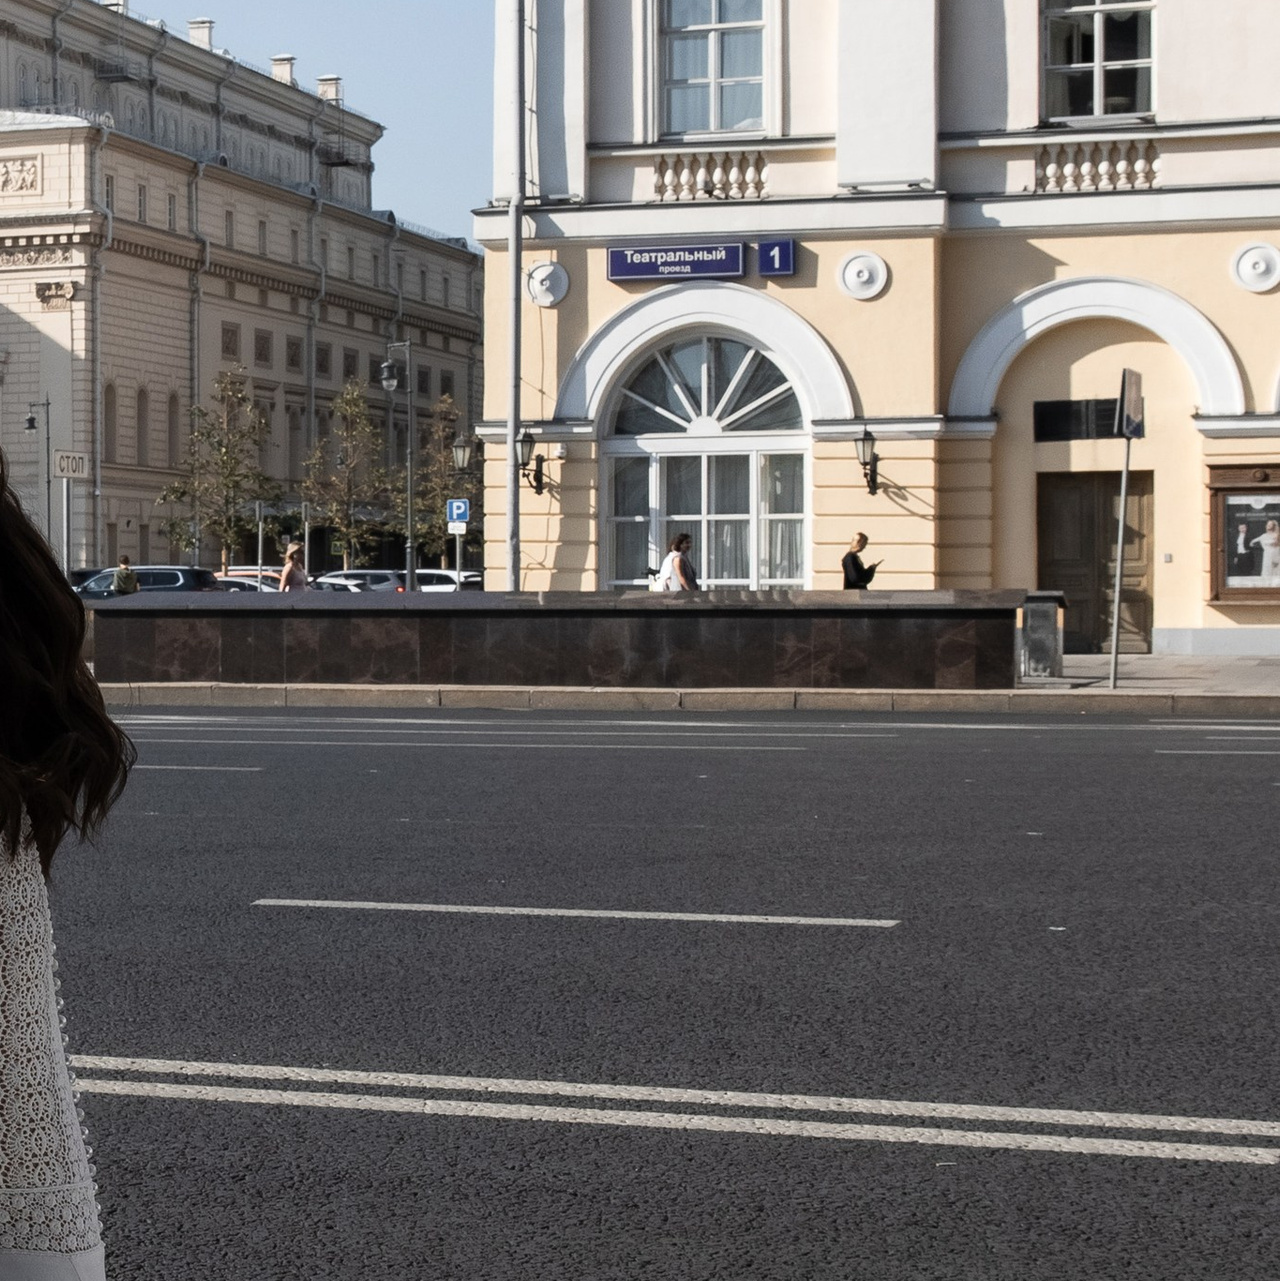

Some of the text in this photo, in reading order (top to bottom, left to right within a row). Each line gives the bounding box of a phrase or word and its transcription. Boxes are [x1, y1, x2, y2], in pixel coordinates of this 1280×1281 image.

[624, 247, 726, 265] Театральный
[769, 246, 780, 269] 1
[658, 265, 691, 274] проезд
[59, 455, 84, 474] СТОП
[452, 501, 466, 520] P
